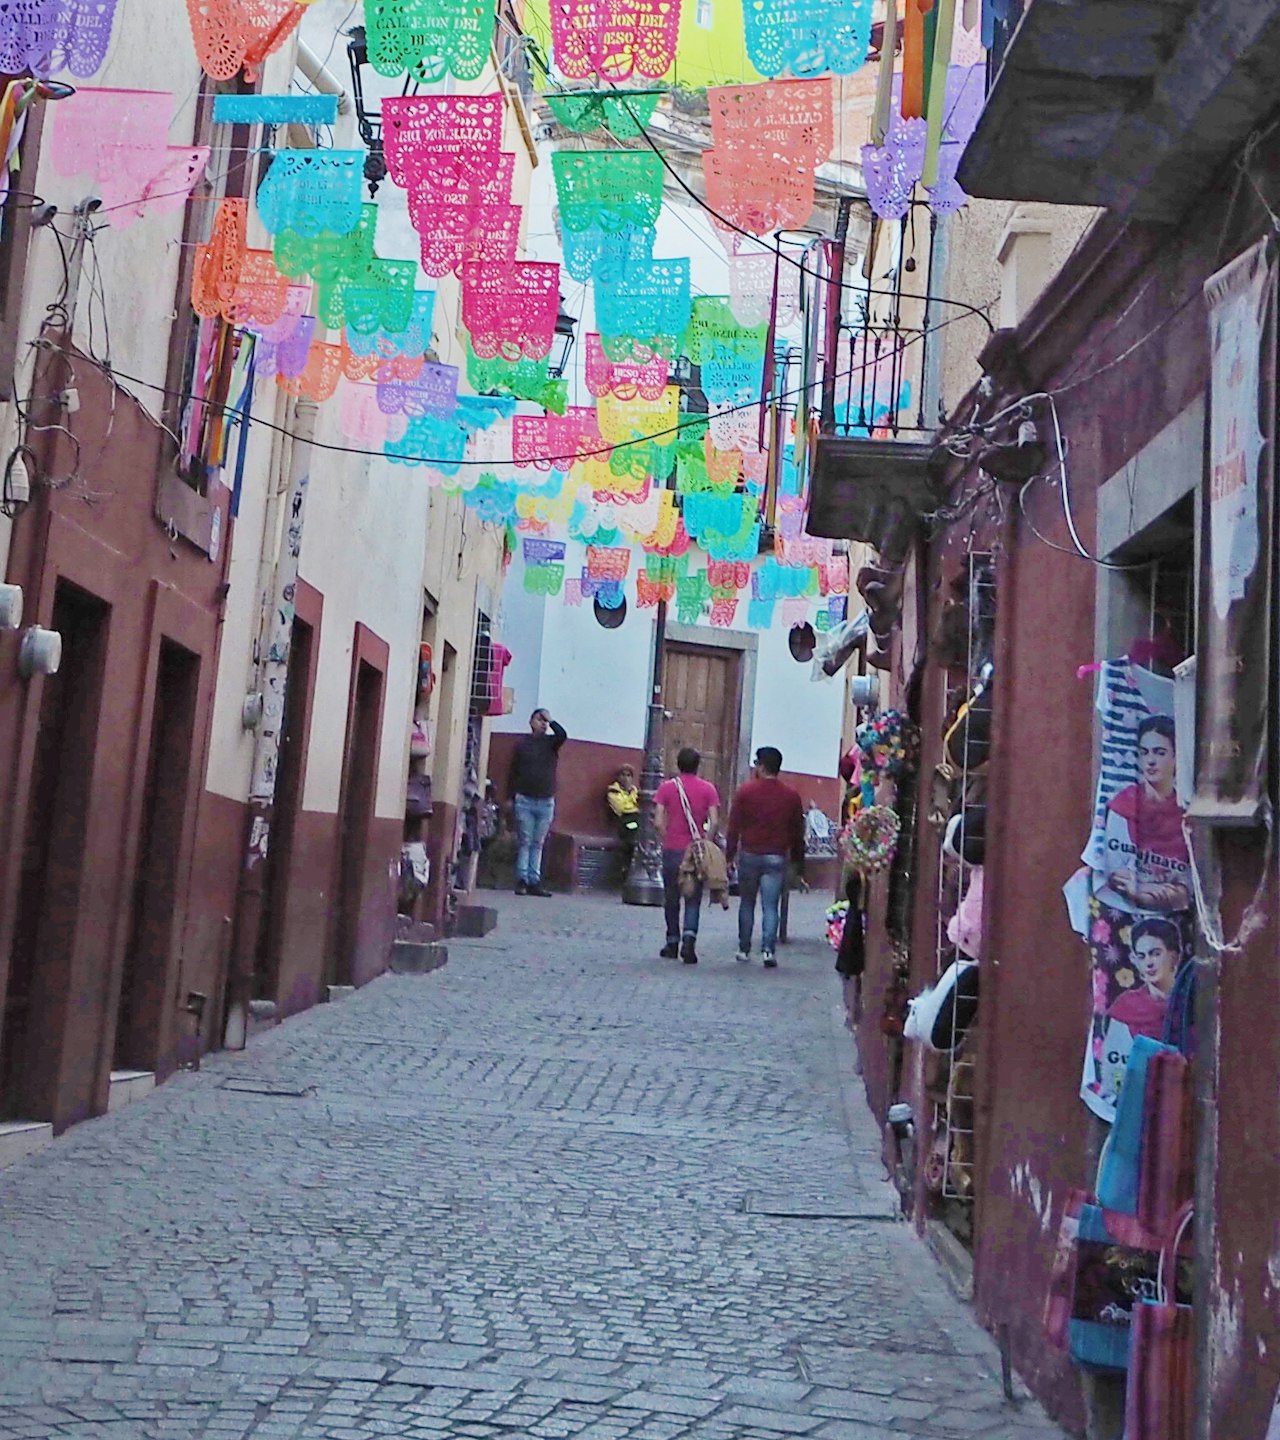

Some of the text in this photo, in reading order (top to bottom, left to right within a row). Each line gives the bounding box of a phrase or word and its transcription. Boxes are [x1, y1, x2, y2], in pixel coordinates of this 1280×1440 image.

[76, 14, 102, 28] DEL
[377, 16, 481, 32] CALLEJON DEL
[640, 13, 668, 28] DEL
[411, 32, 446, 47] BESO
[613, 367, 638, 378] BESO
